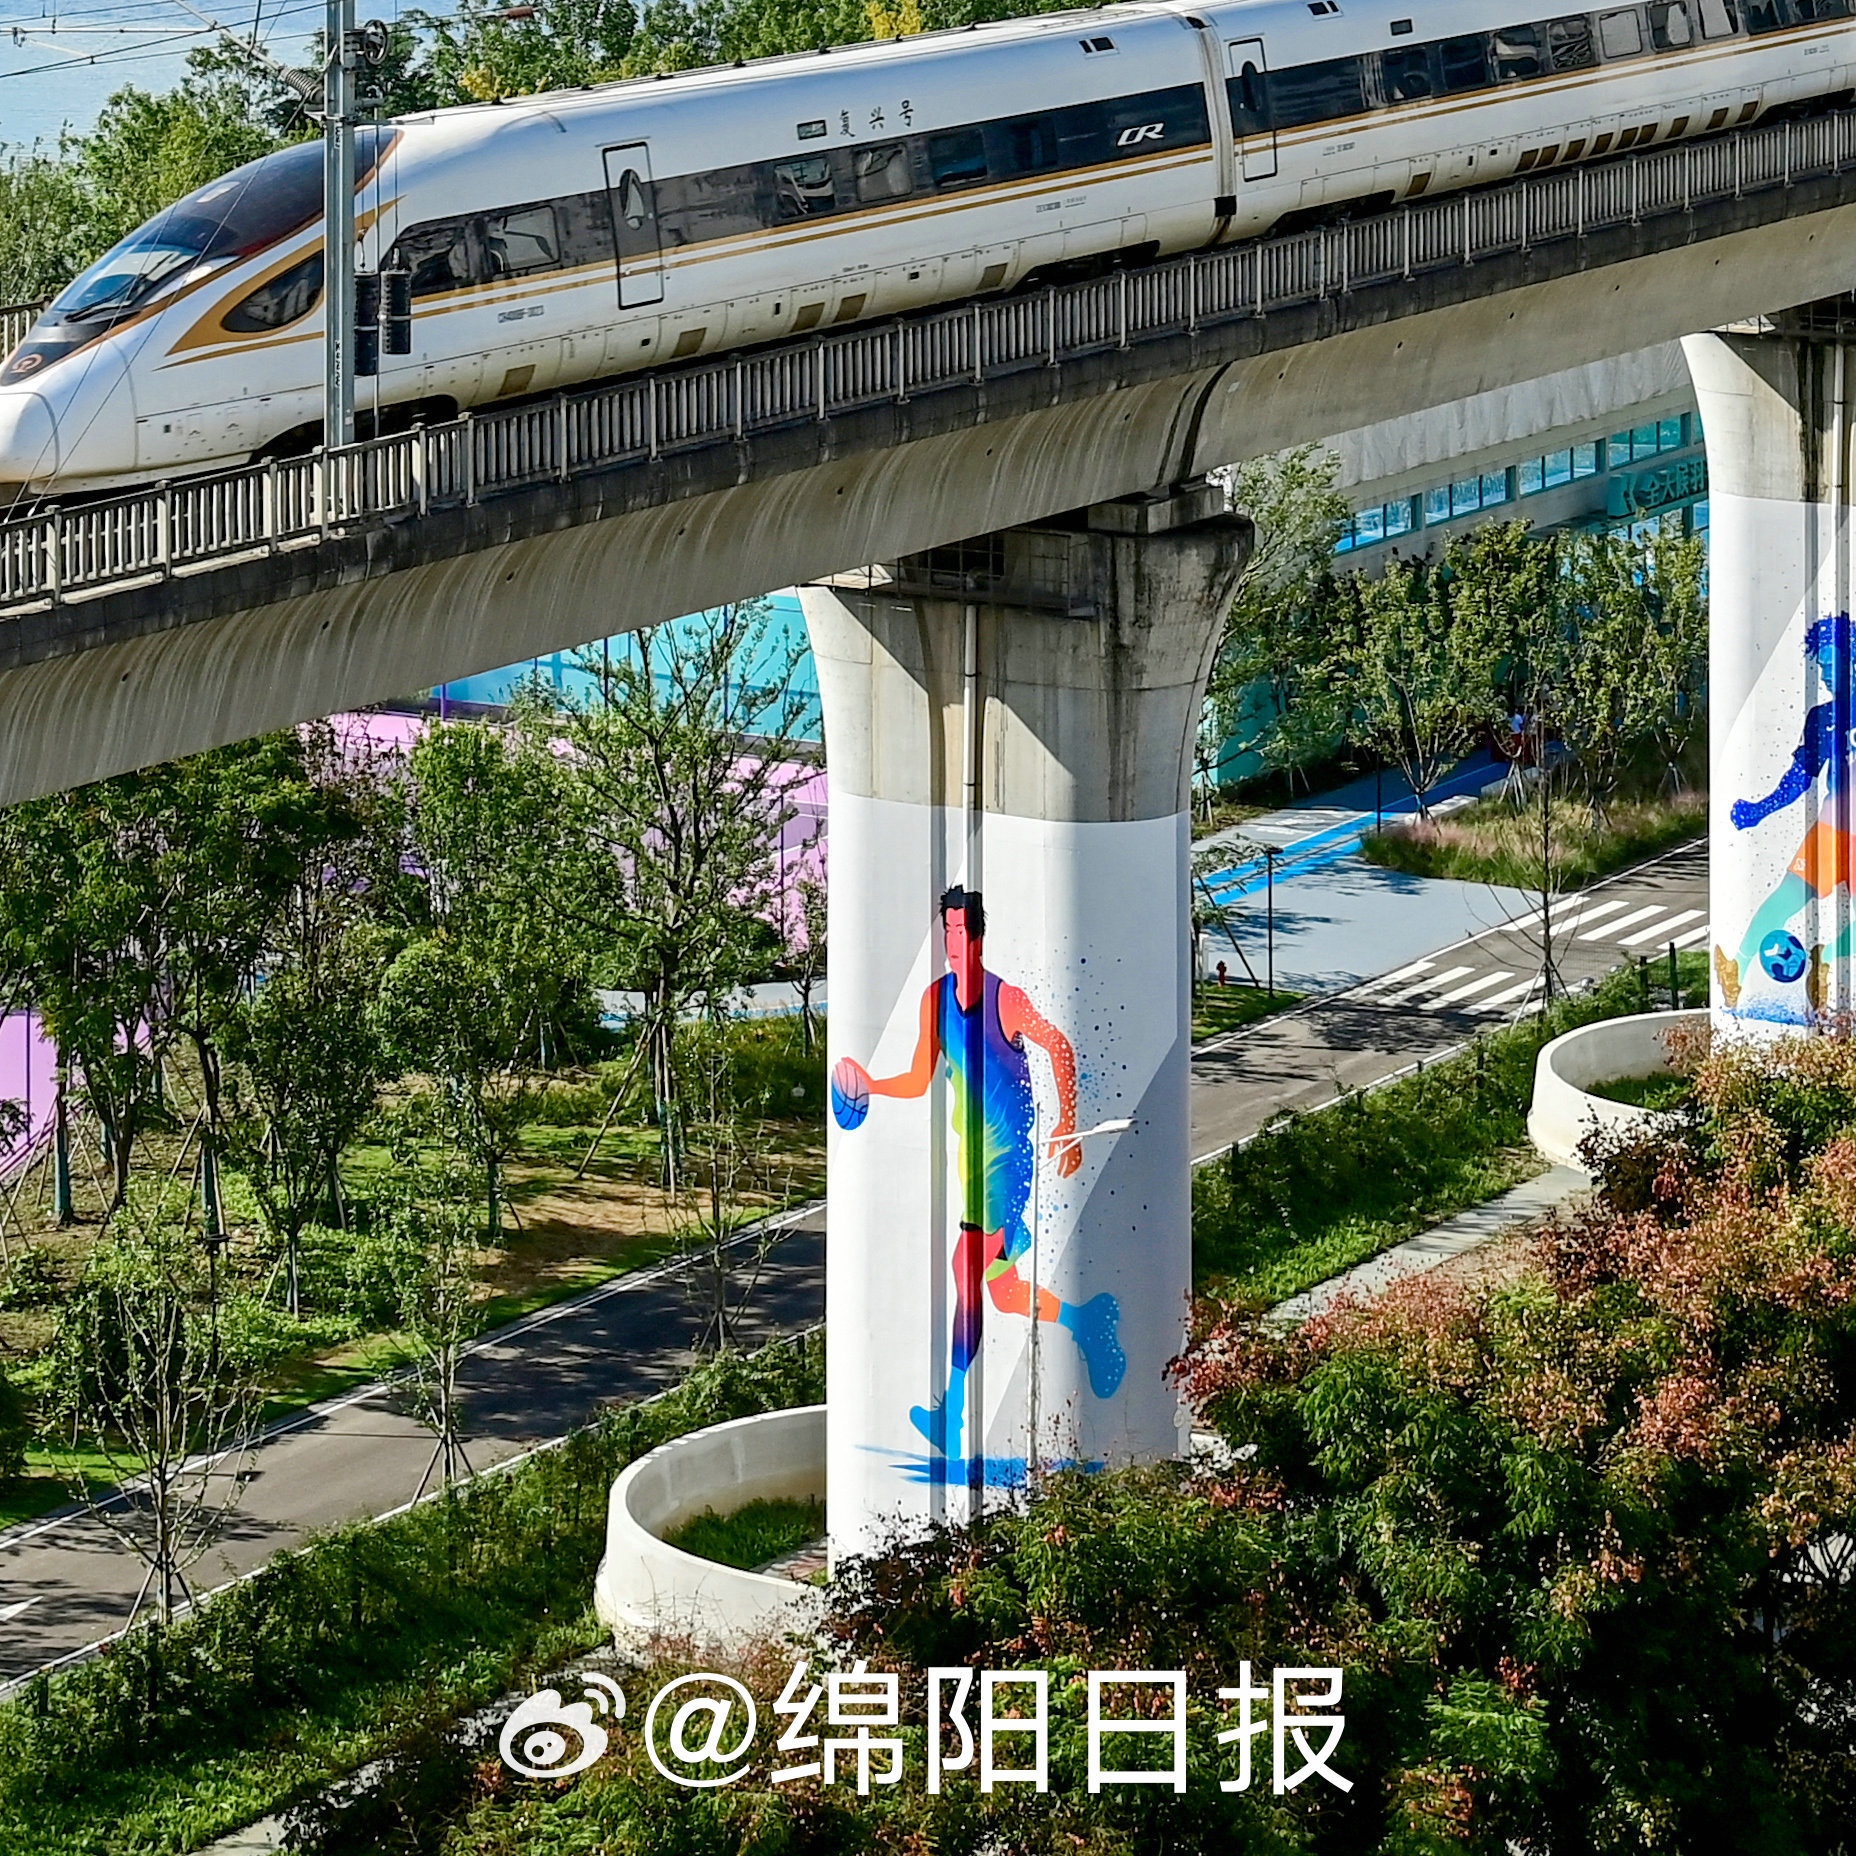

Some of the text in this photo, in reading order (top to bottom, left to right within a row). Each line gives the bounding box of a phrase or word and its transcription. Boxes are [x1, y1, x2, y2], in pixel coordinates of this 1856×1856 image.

[839, 99, 914, 138] 复兴号
[1117, 122, 1165, 147] CR
